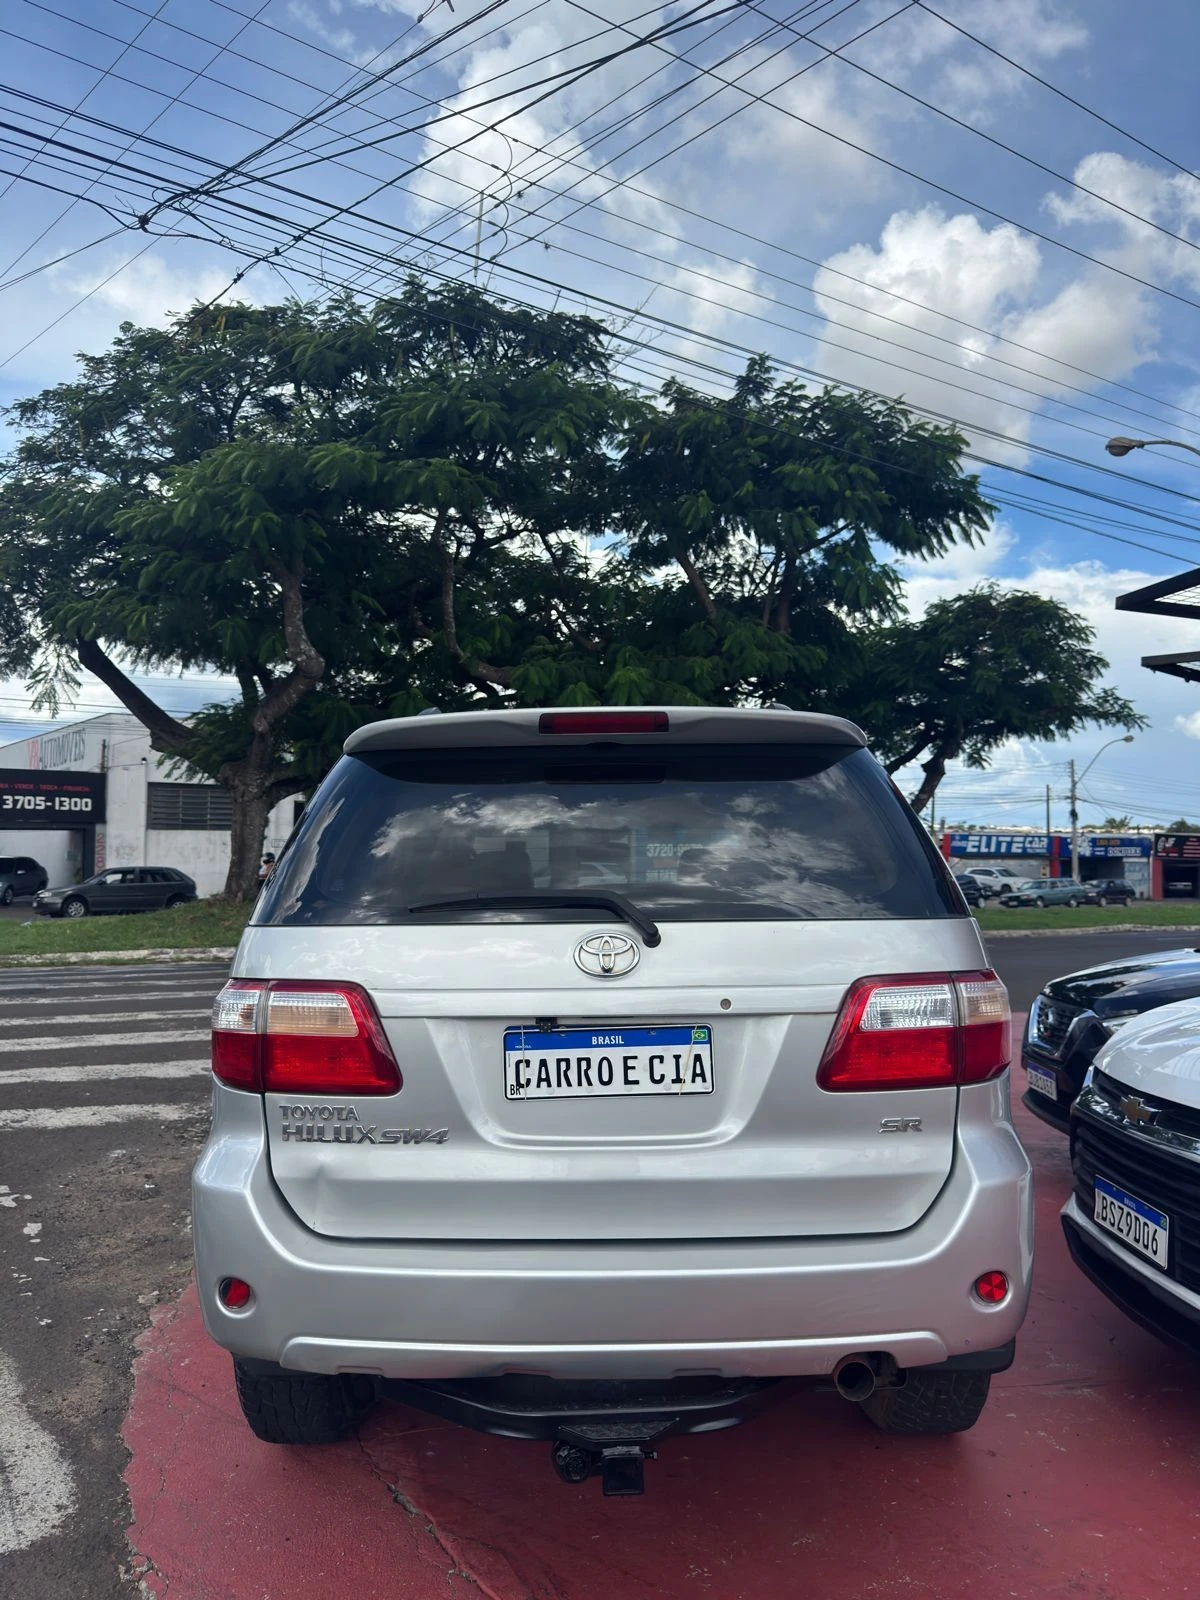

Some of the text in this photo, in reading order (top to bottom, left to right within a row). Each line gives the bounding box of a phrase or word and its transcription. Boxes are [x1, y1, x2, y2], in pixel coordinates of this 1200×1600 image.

[3, 795, 92, 811] 3705-1300
[966, 836, 1025, 853] ELITE
[1025, 836, 1048, 848] CAR
[591, 1035, 625, 1045] BRASIL
[279, 1105, 360, 1121] TOYOTA
[880, 1117, 922, 1132] SR
[282, 1123, 449, 1144] HILUX SW4
[1101, 1195, 1159, 1256] BSZ9D06
